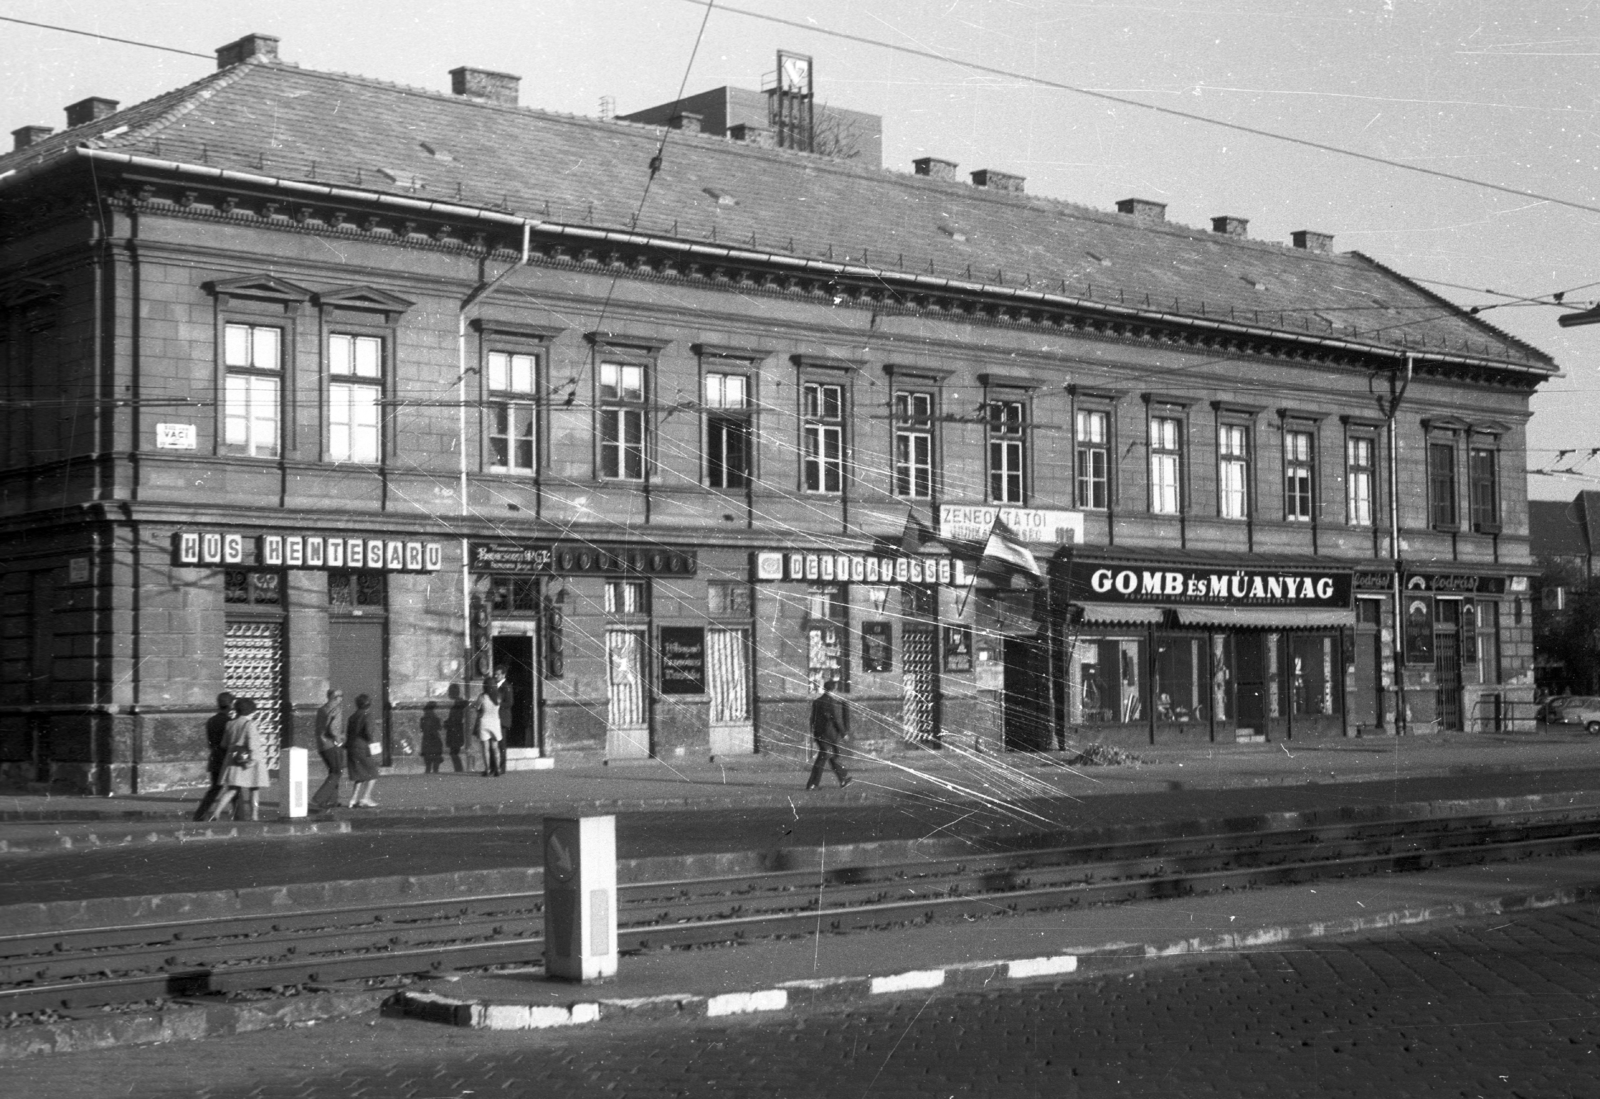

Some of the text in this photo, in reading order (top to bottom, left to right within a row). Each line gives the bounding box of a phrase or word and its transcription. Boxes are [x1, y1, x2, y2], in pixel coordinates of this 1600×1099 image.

[185, 535, 440, 566] HÚS HENTESÁRU
[793, 559, 949, 580] DELICATESSE
[1091, 569, 1334, 599] GOMB ÉS MŰANYAG
